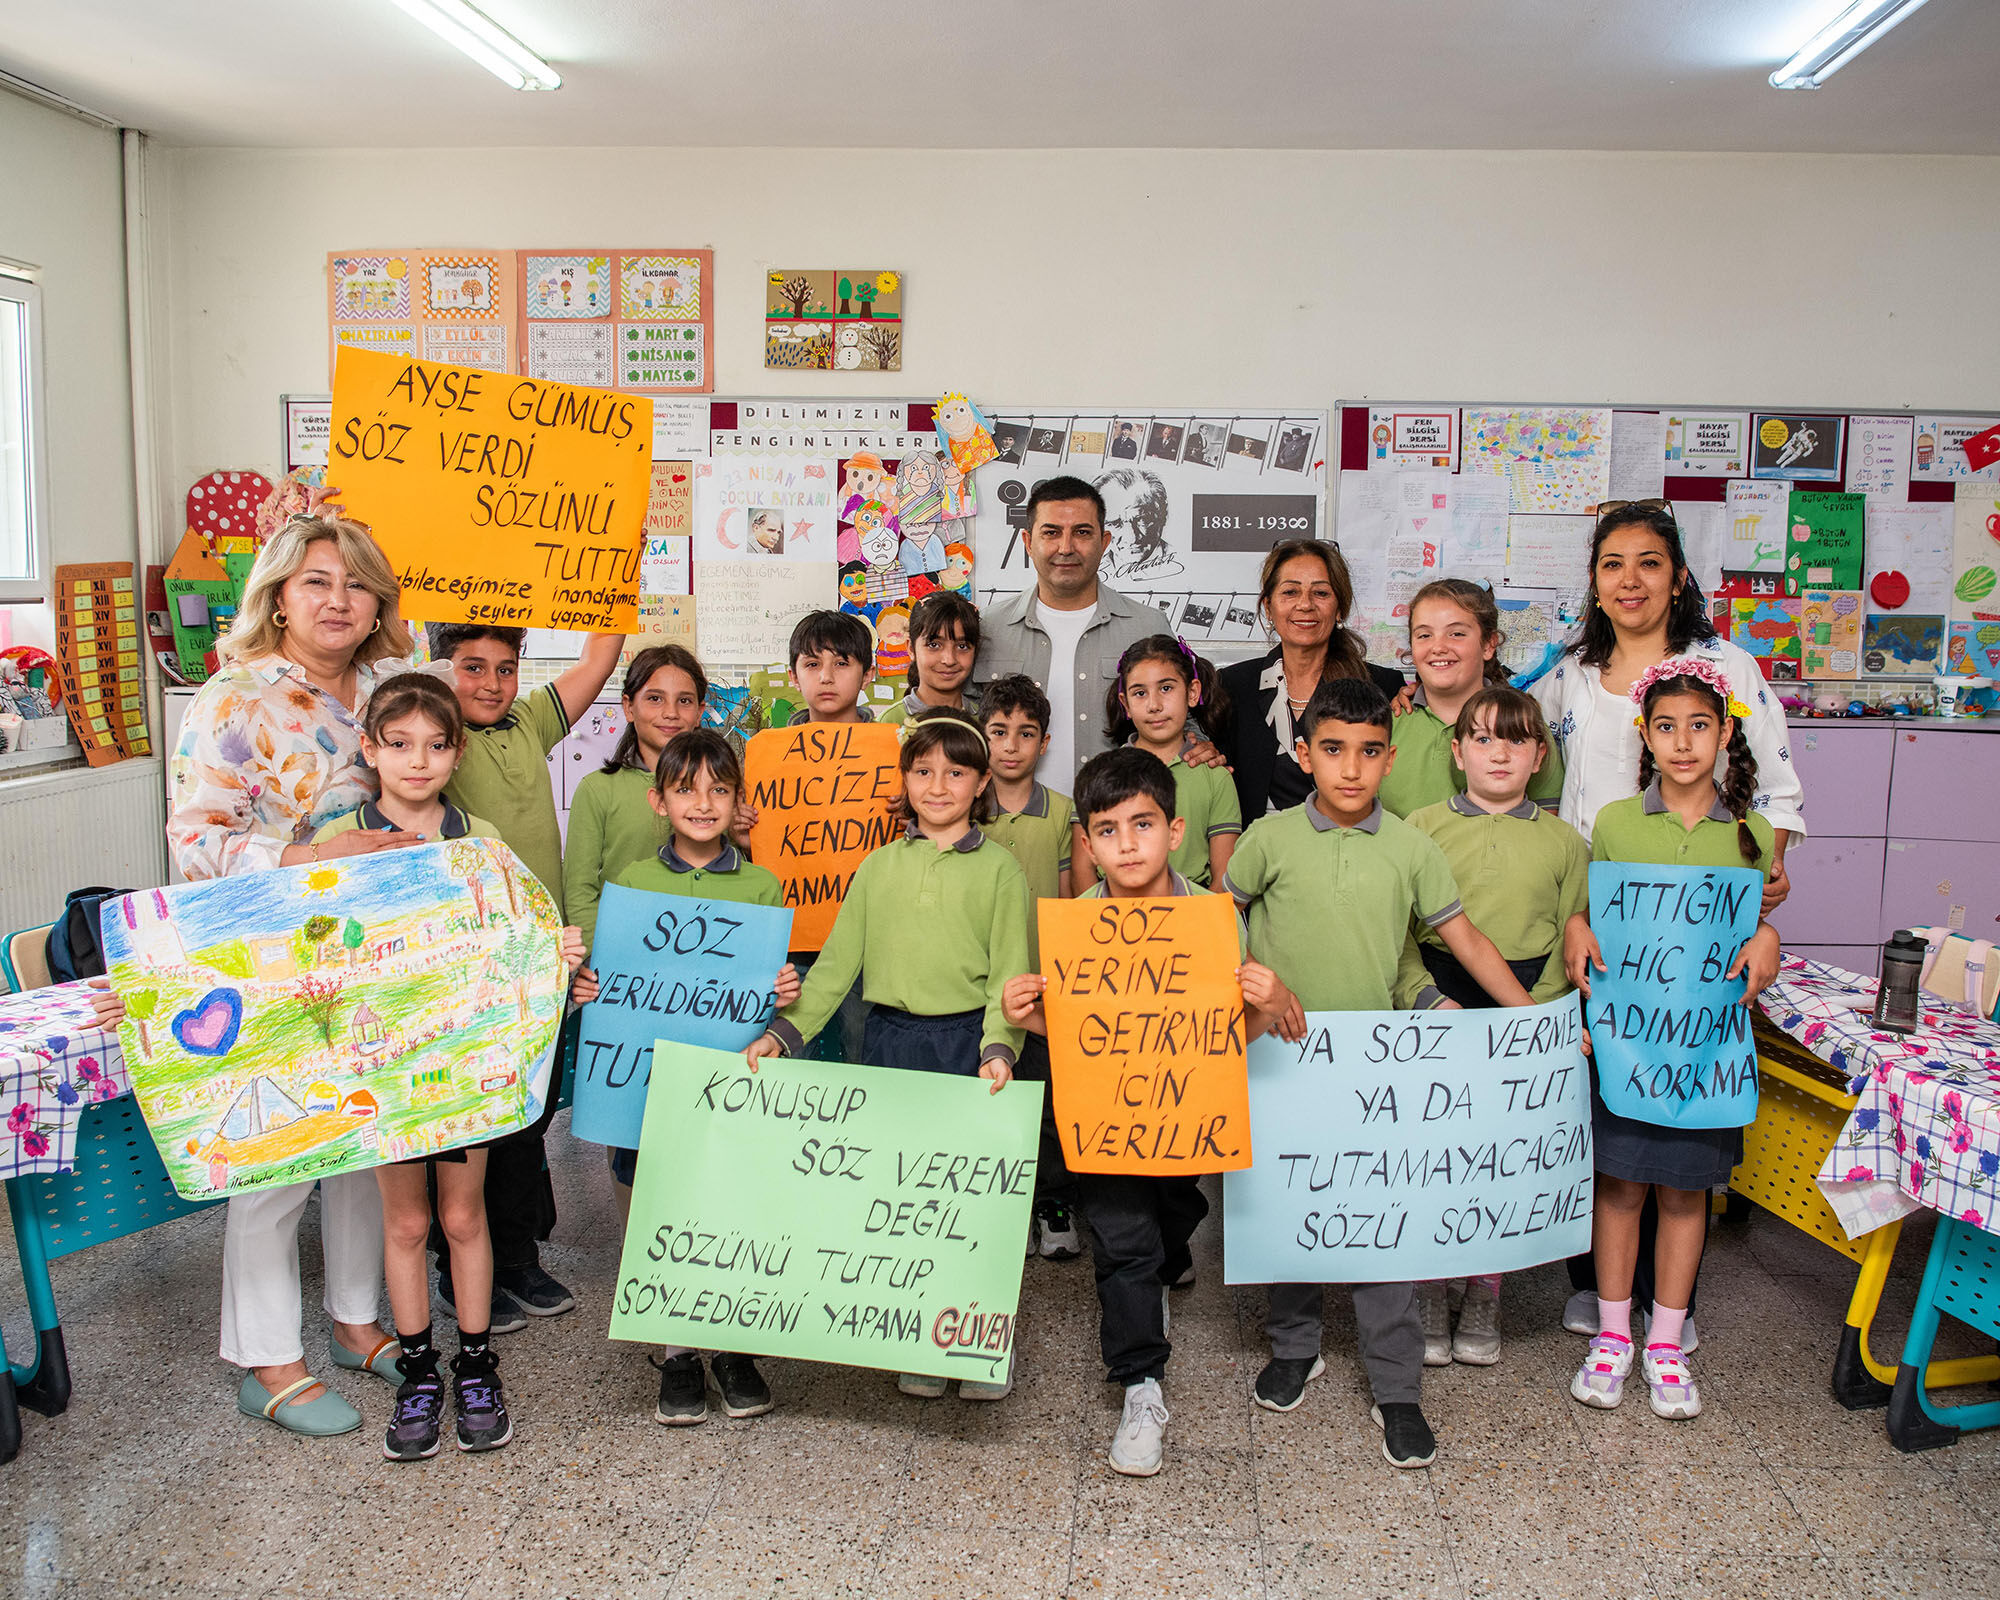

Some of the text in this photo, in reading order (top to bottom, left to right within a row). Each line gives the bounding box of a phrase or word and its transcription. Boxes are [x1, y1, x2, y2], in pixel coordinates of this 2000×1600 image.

[362, 269, 377, 277] YAZ
[560, 268, 575, 278] KIŞ
[445, 328, 487, 341] EYLÜL
[645, 328, 680, 341] MART
[447, 348, 482, 362] EKİM
[640, 347, 683, 361] NİSAN
[641, 369, 683, 382] MAYIS
[387, 364, 483, 418] AYŞE
[1414, 418, 1433, 426] FEN
[1406, 426, 1440, 434] BİLGİSİ
[1696, 431, 1731, 439] BİLGİSİ
[335, 410, 536, 480] SÖZ VERDİ
[1410, 435, 1437, 443] DERSİ
[1947, 467, 1954, 477] 3
[1955, 460, 1961, 470] 7
[1960, 466, 1968, 476] 6
[655, 479, 669, 487] VE
[659, 487, 690, 498] OLAN
[471, 481, 615, 536] SÖZÜNÜ
[1201, 515, 1242, 530] 1881
[169, 581, 195, 593] ONLUK
[59, 614, 69, 627] III
[94, 610, 110, 621] XIV
[464, 603, 619, 630] şeyleri yaparız.
[59, 631, 70, 645] IV
[96, 625, 109, 637] XV
[97, 641, 112, 652] XVI
[189, 635, 206, 650] EVİ
[60, 646, 68, 659] V
[61, 662, 72, 676] VI
[64, 678, 76, 692] VII
[103, 701, 115, 713] XX
[71, 709, 83, 722] IX
[106, 716, 115, 730] L
[111, 730, 119, 743] C
[84, 739, 96, 751] XI
[783, 726, 863, 763] ASIL
[751, 764, 897, 810] MUCİZE
[1601, 873, 1751, 929] ATTIĞIN
[1090, 900, 1176, 945] SÖZ
[643, 902, 744, 959] SÖZ
[1619, 935, 1684, 994] HİÇ
[1054, 950, 1192, 996] YERİNE
[1078, 1006, 1246, 1057] GETİRMEK
[1592, 1001, 1752, 1049] ADIMDAN
[1364, 1013, 1453, 1064] SÖZ
[1487, 1007, 1578, 1060] VERME
[1625, 1050, 1759, 1102] KORKMA
[695, 1069, 867, 1131] KONUŞUP
[1355, 1066, 1576, 1125] YA DA TUT.
[1072, 1113, 1240, 1161] VERİLİR.
[1278, 1120, 1594, 1193] TUTAMAYACAĞIN
[792, 1136, 1038, 1197] SÖZ VERENE
[864, 1198, 980, 1253] DEĞİL,
[1296, 1201, 1408, 1251] SÖZÜ
[647, 1219, 936, 1299] SÖZÜNÜ TUTUP,
[617, 1273, 1017, 1354] SÖYLEDİĞİNİ YAPANA GÜVEN
